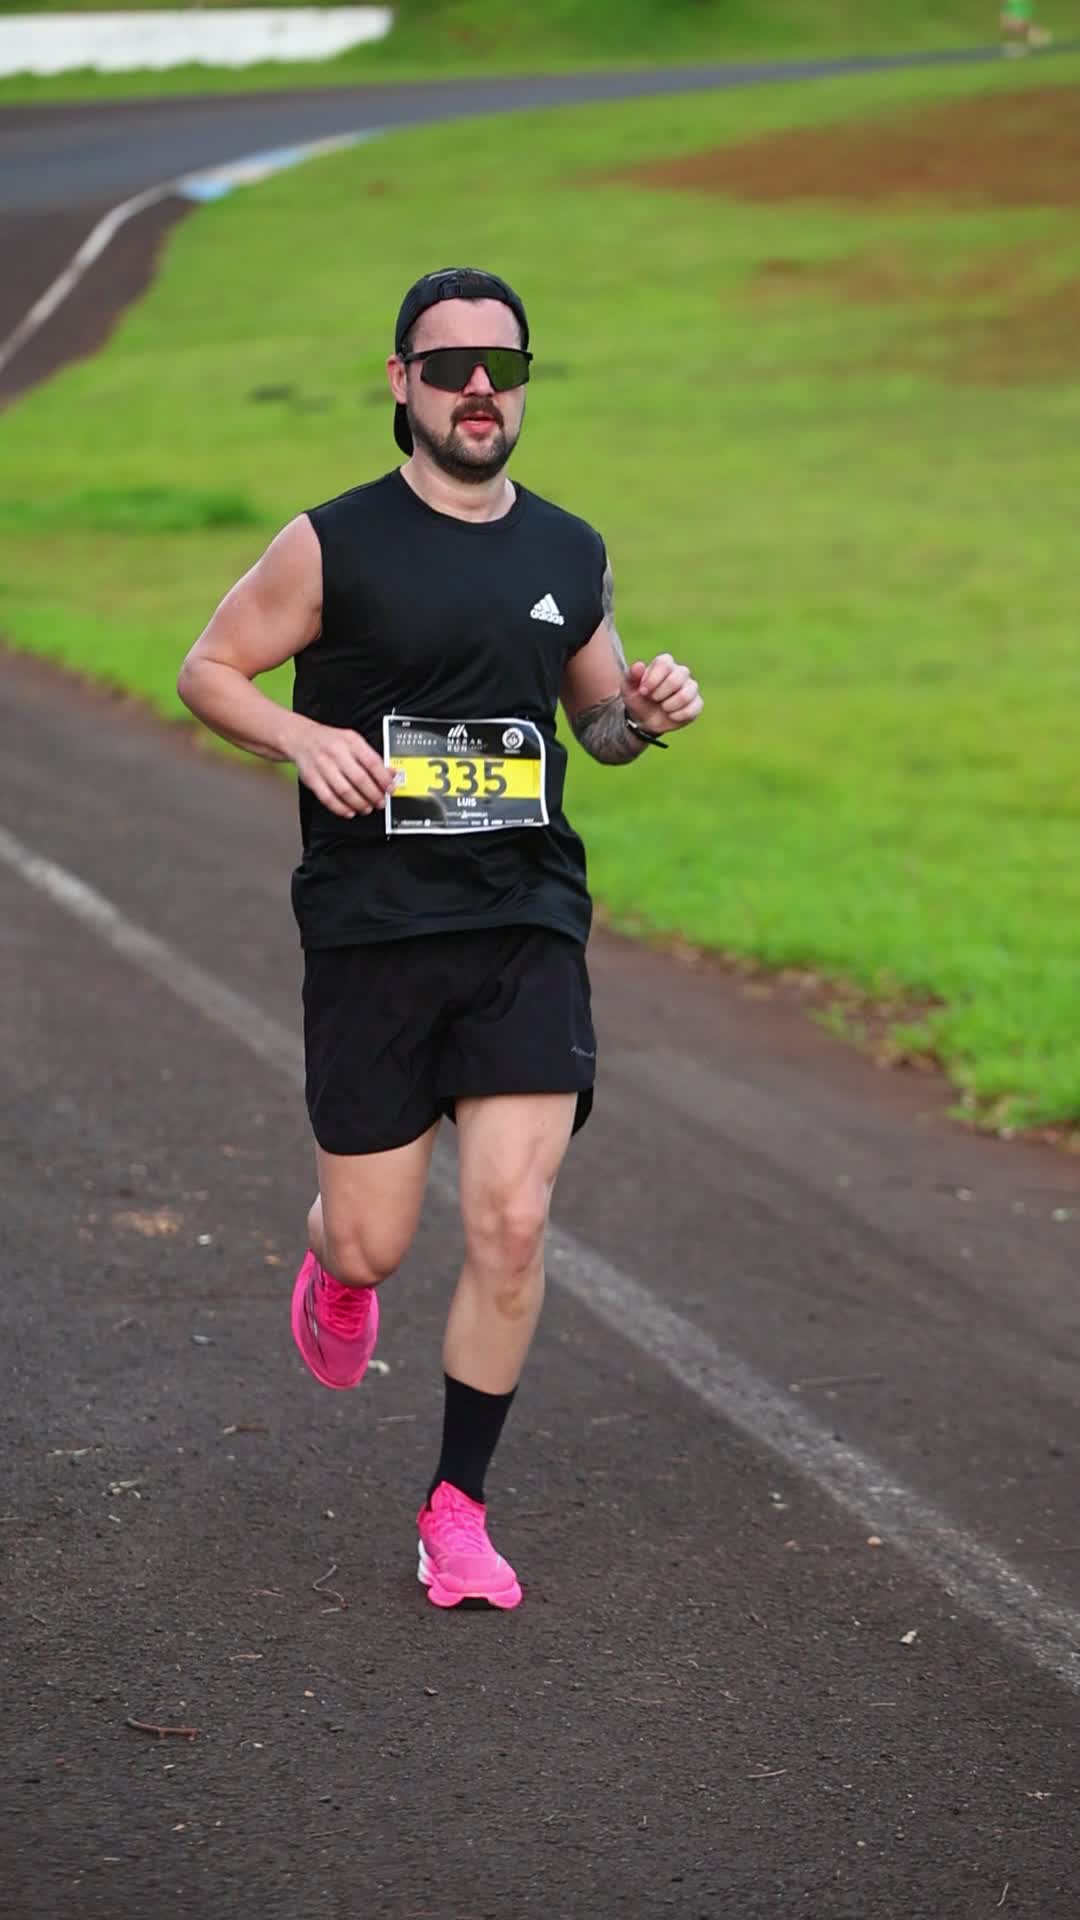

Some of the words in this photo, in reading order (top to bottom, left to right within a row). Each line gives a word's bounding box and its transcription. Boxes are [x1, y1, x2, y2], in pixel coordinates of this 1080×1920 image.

[530, 608, 565, 626] adidas
[427, 759, 507, 796] 335
[457, 798, 477, 807] LUIS
